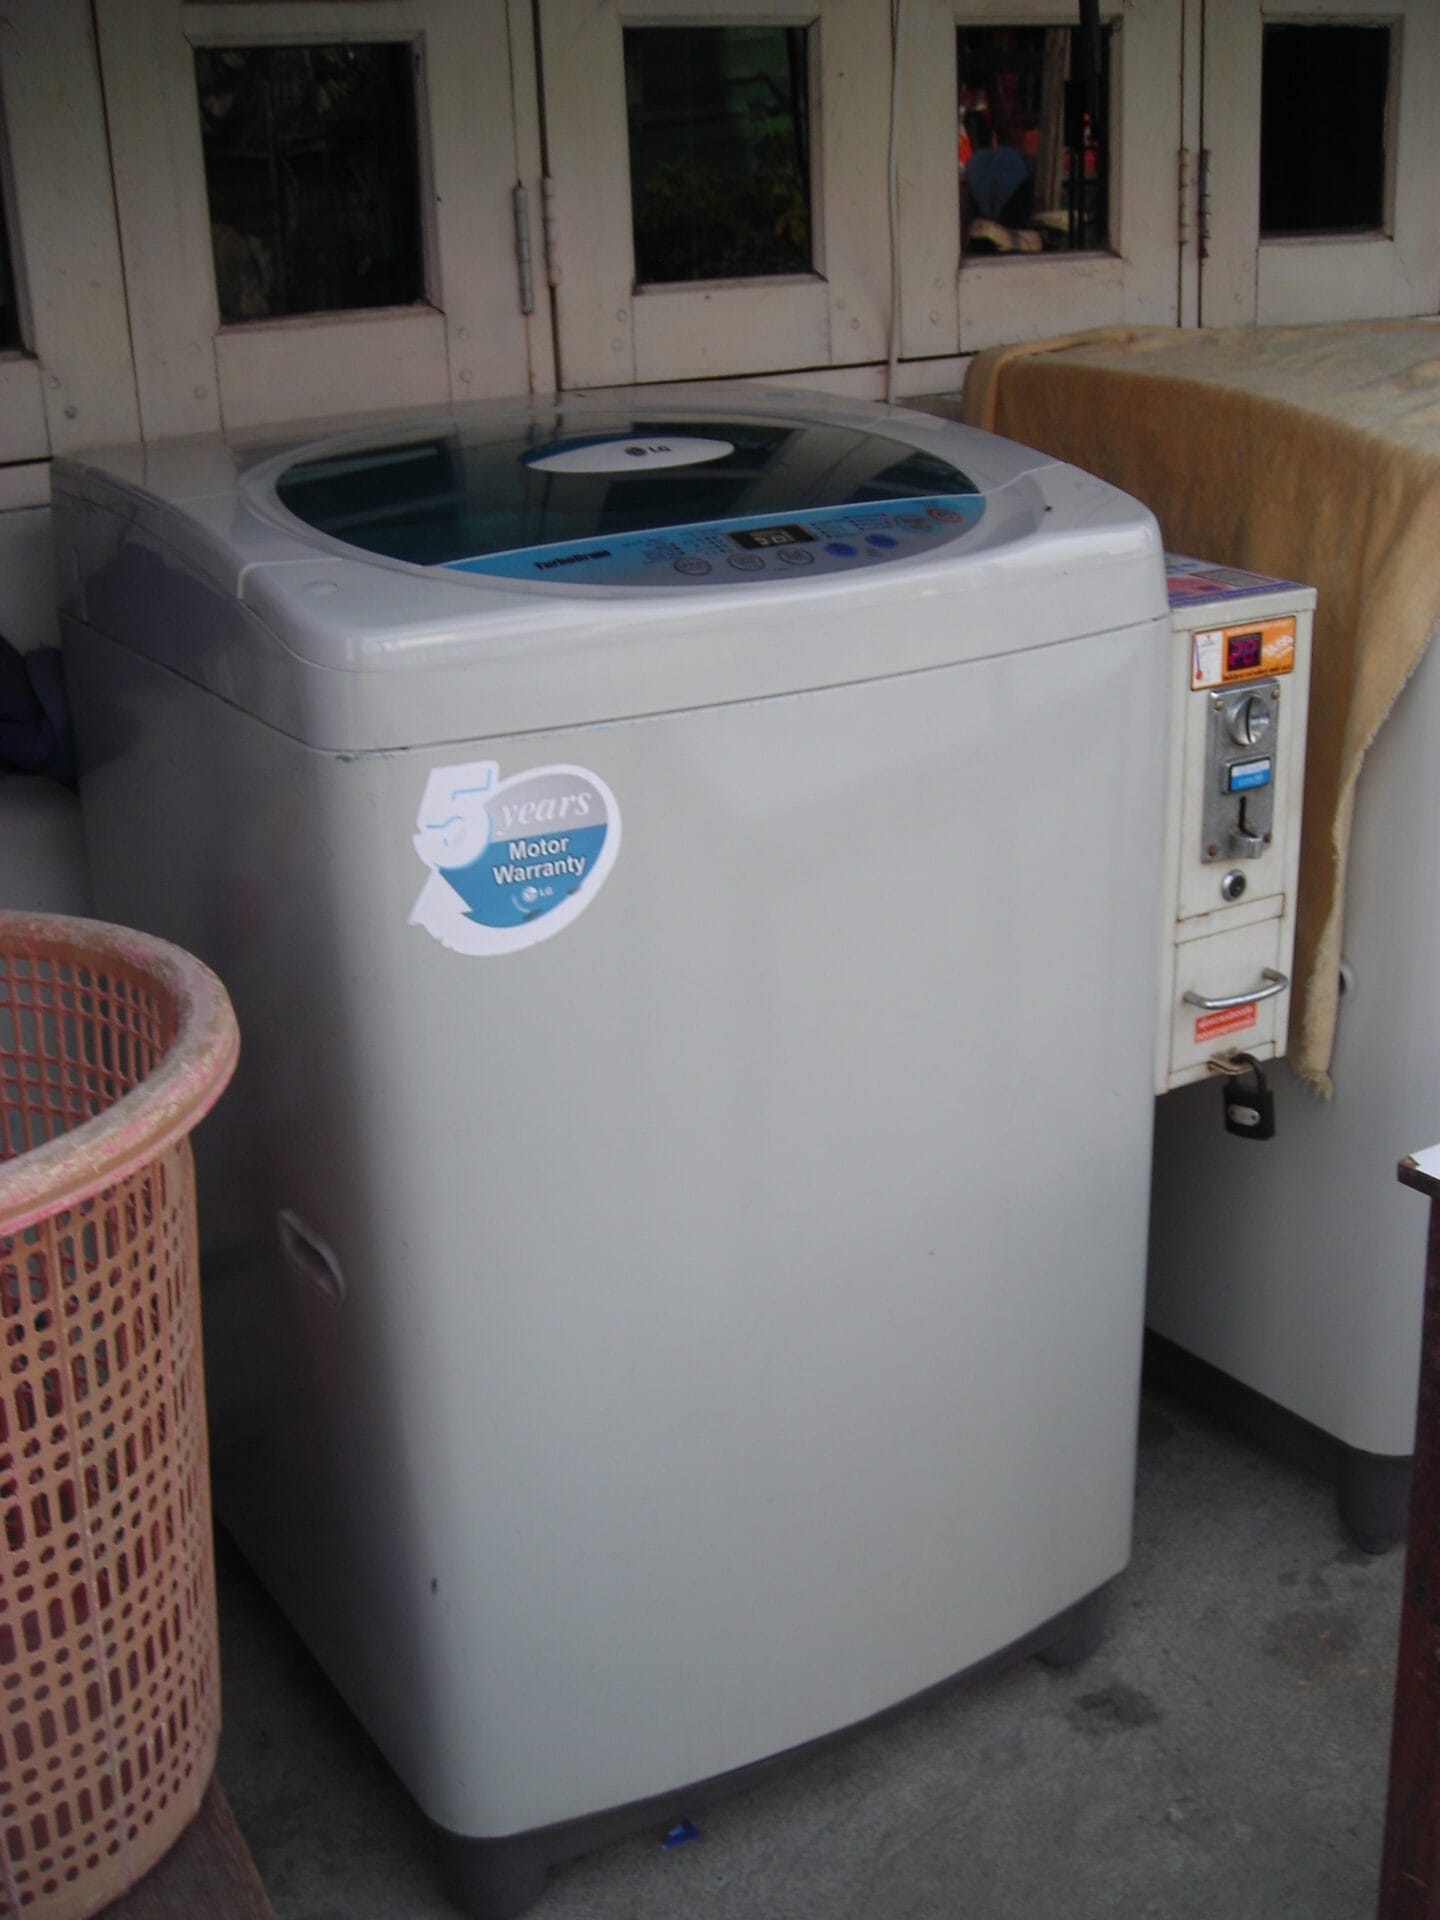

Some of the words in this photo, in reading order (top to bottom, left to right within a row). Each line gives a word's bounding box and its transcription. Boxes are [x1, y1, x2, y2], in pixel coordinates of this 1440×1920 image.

[413, 761, 498, 869] 5
[496, 792, 592, 836] years
[508, 837, 570, 861] Motor
[492, 855, 587, 885] Warranty
[539, 886, 553, 897] LG
